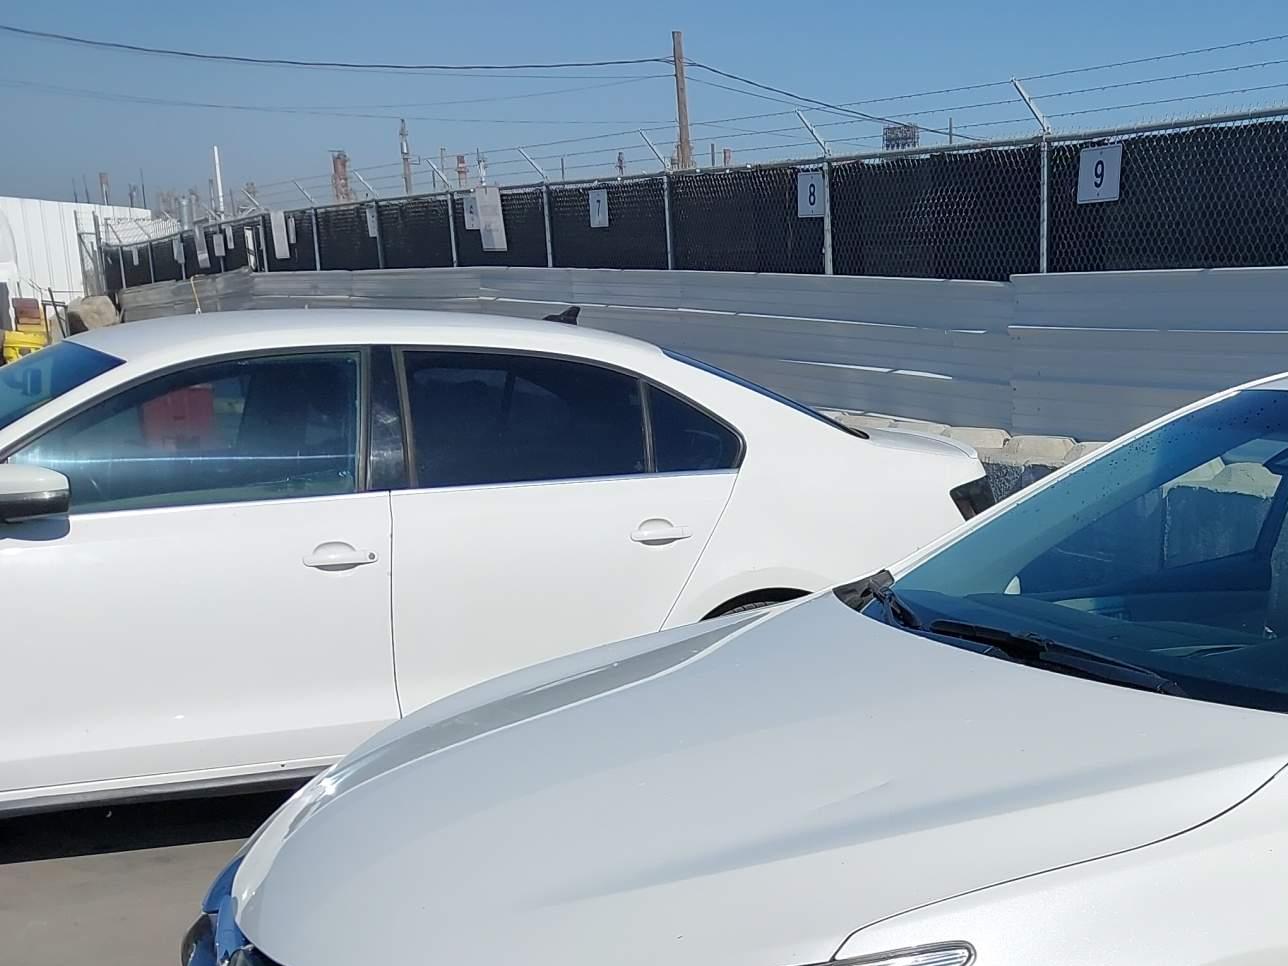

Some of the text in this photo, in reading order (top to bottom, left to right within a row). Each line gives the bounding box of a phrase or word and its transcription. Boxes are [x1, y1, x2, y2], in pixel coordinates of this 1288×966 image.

[1094, 160, 1104, 188] 9
[808, 183, 816, 206] 8
[596, 199, 602, 217] 7
